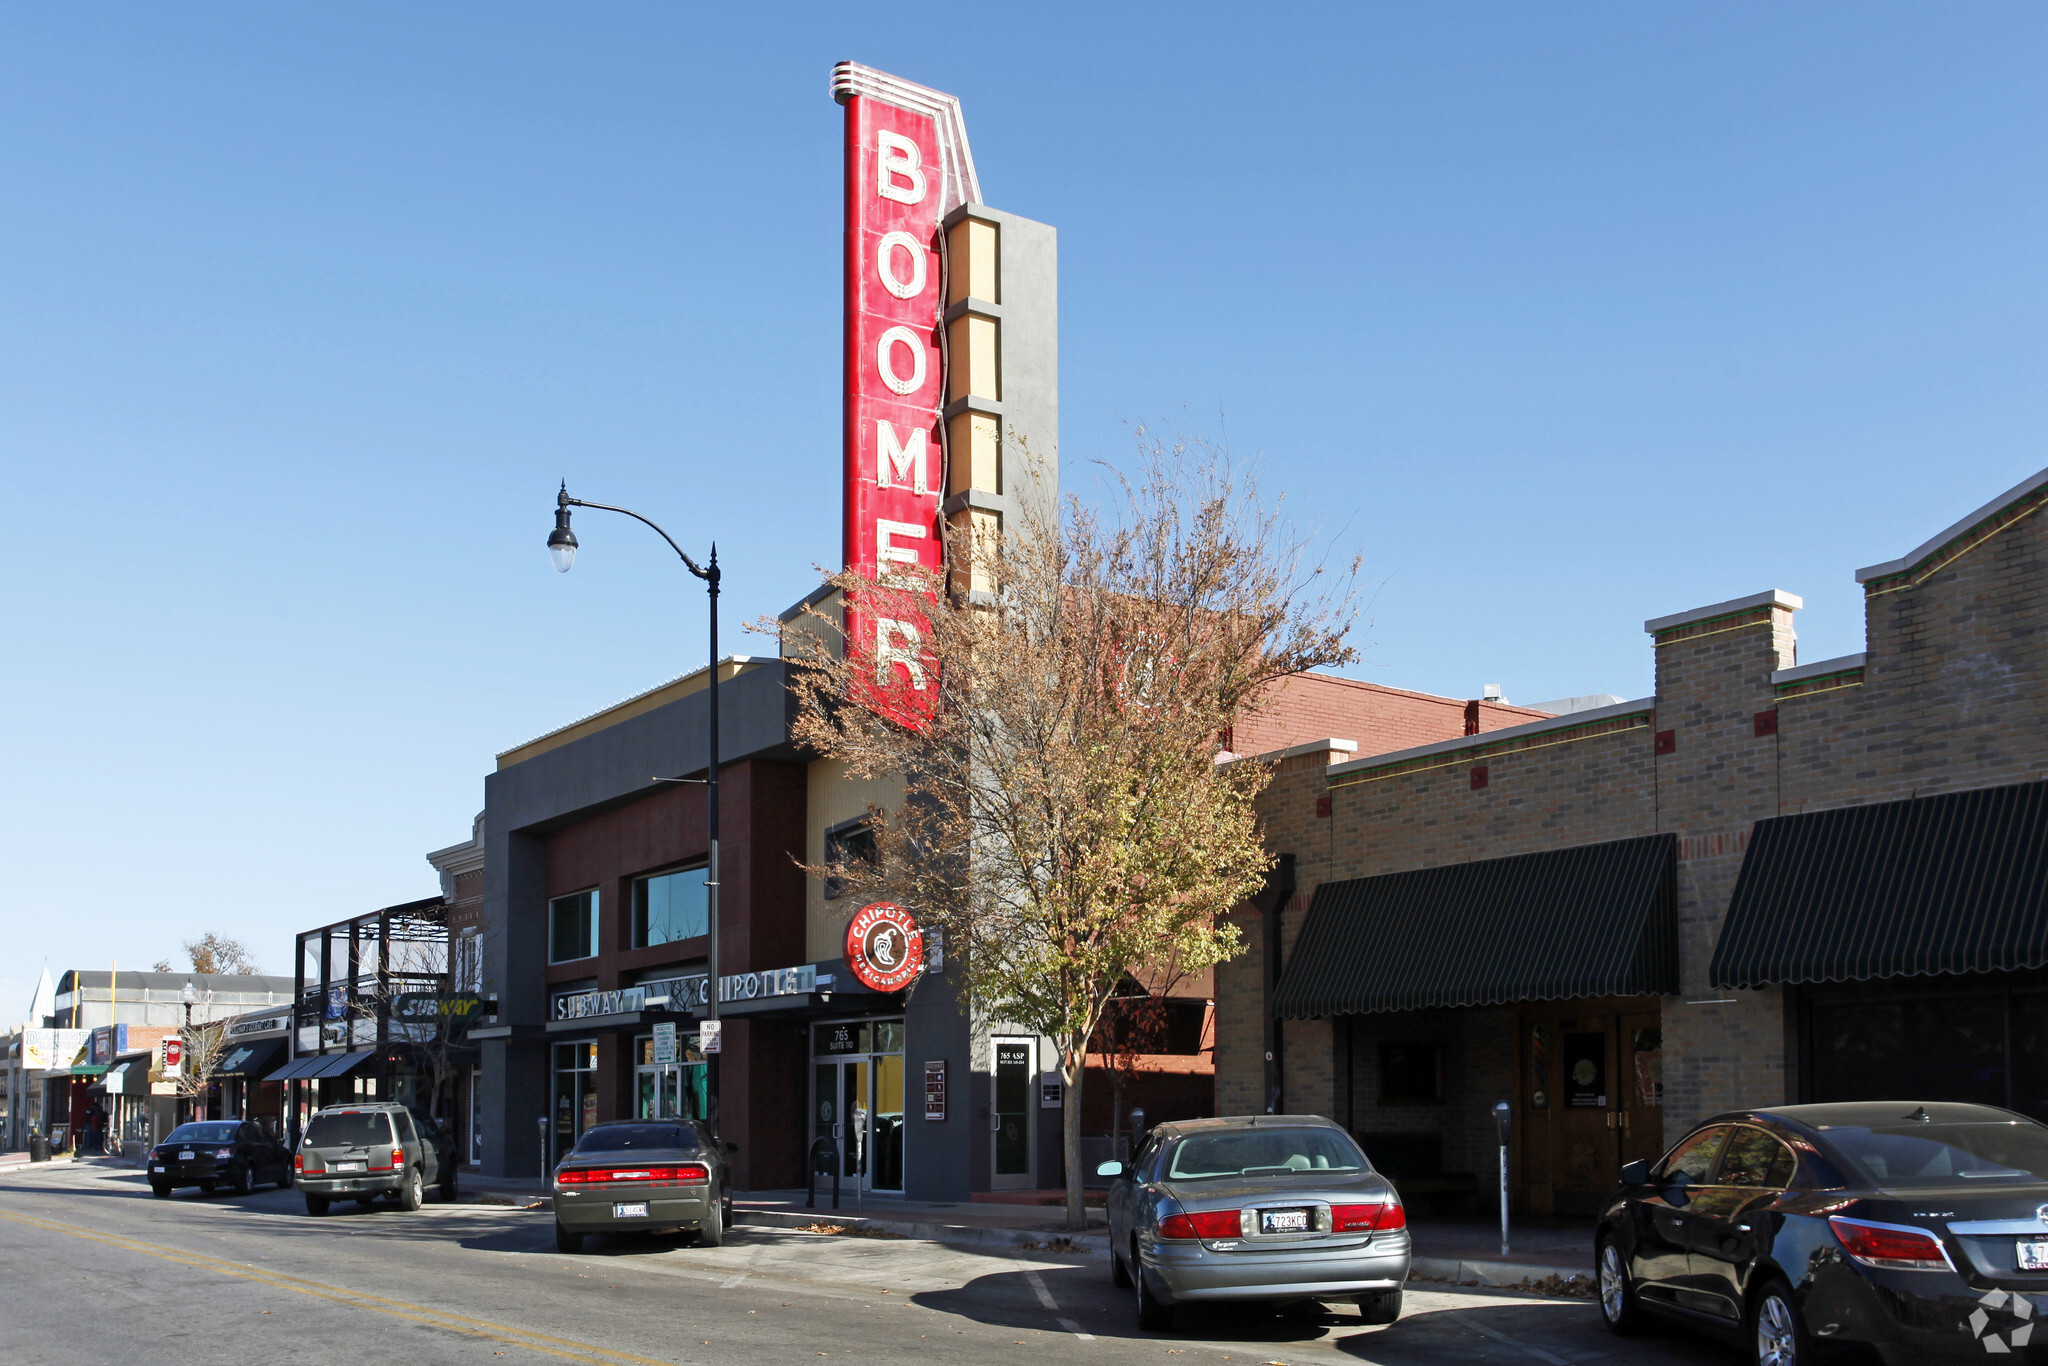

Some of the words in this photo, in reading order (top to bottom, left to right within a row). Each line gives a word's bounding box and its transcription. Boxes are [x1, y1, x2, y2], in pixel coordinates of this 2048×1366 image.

[875, 128, 928, 691] BOOMER
[853, 906, 919, 941] CHIPOTLE
[855, 954, 894, 985] MEXICAN
[700, 967, 798, 1003] CHIPOTLE
[402, 999, 479, 1016] SUBWAY
[557, 990, 623, 1020] SUBWAY
[829, 1041, 845, 1050] SUITE
[834, 1030, 849, 1041] 765
[1000, 1052, 1011, 1060] 765
[1011, 1052, 1025, 1060] ASP
